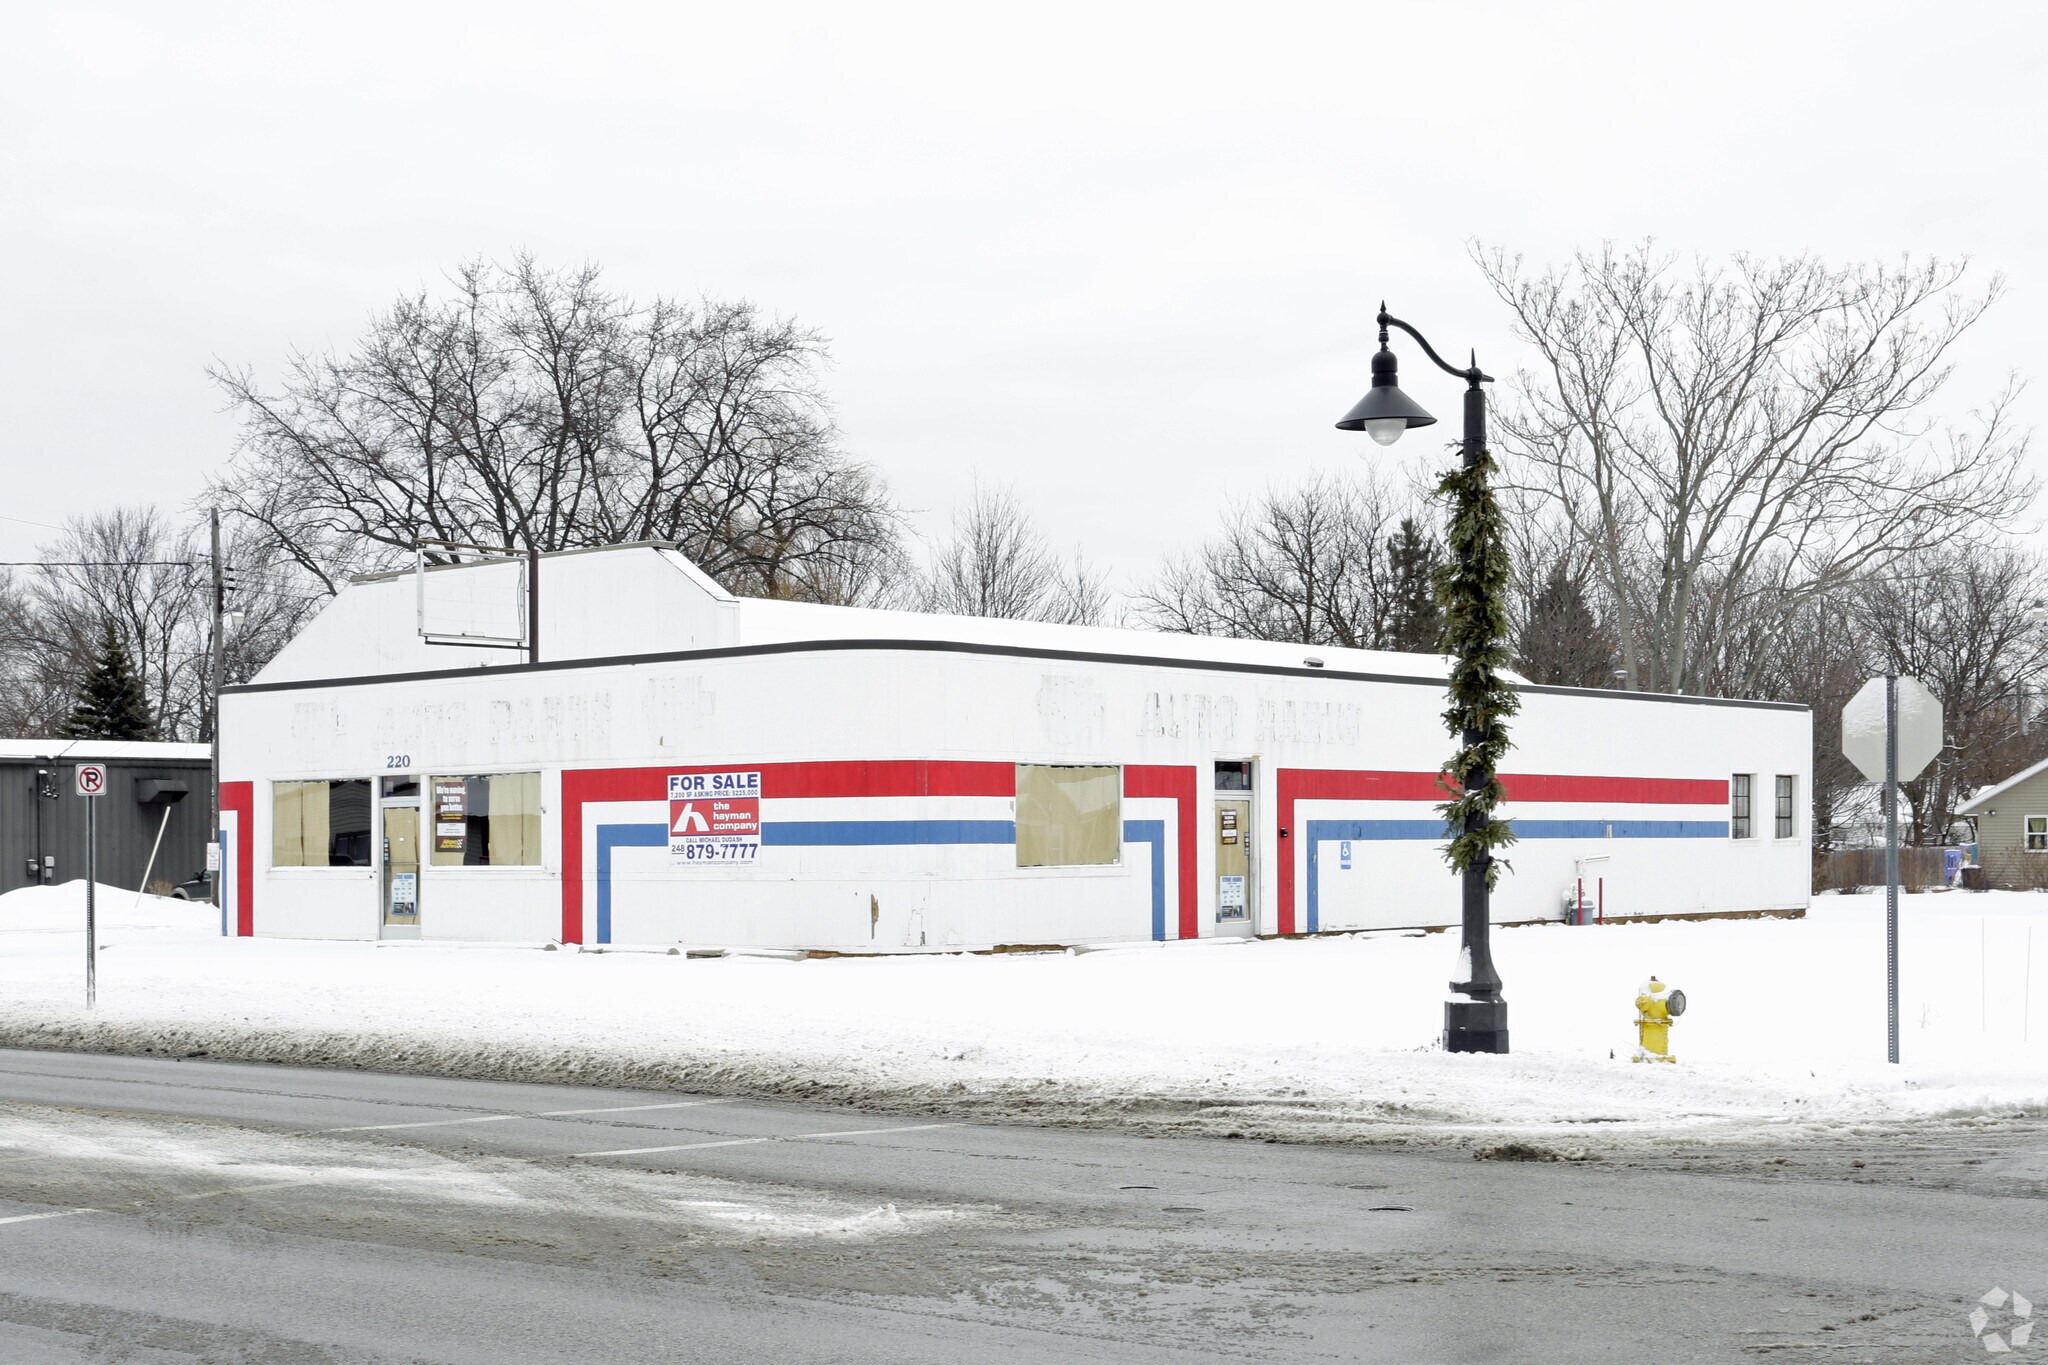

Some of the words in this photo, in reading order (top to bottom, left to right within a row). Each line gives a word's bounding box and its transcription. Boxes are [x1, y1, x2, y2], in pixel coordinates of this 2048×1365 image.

[386, 755, 411, 769] 220
[670, 776, 705, 791] FOR
[712, 774, 758, 790] SALE
[713, 802, 730, 811] the
[713, 811, 751, 822] hayman
[713, 822, 758, 831] company
[671, 844, 685, 852] 248
[686, 843, 758, 860] 879-7777
